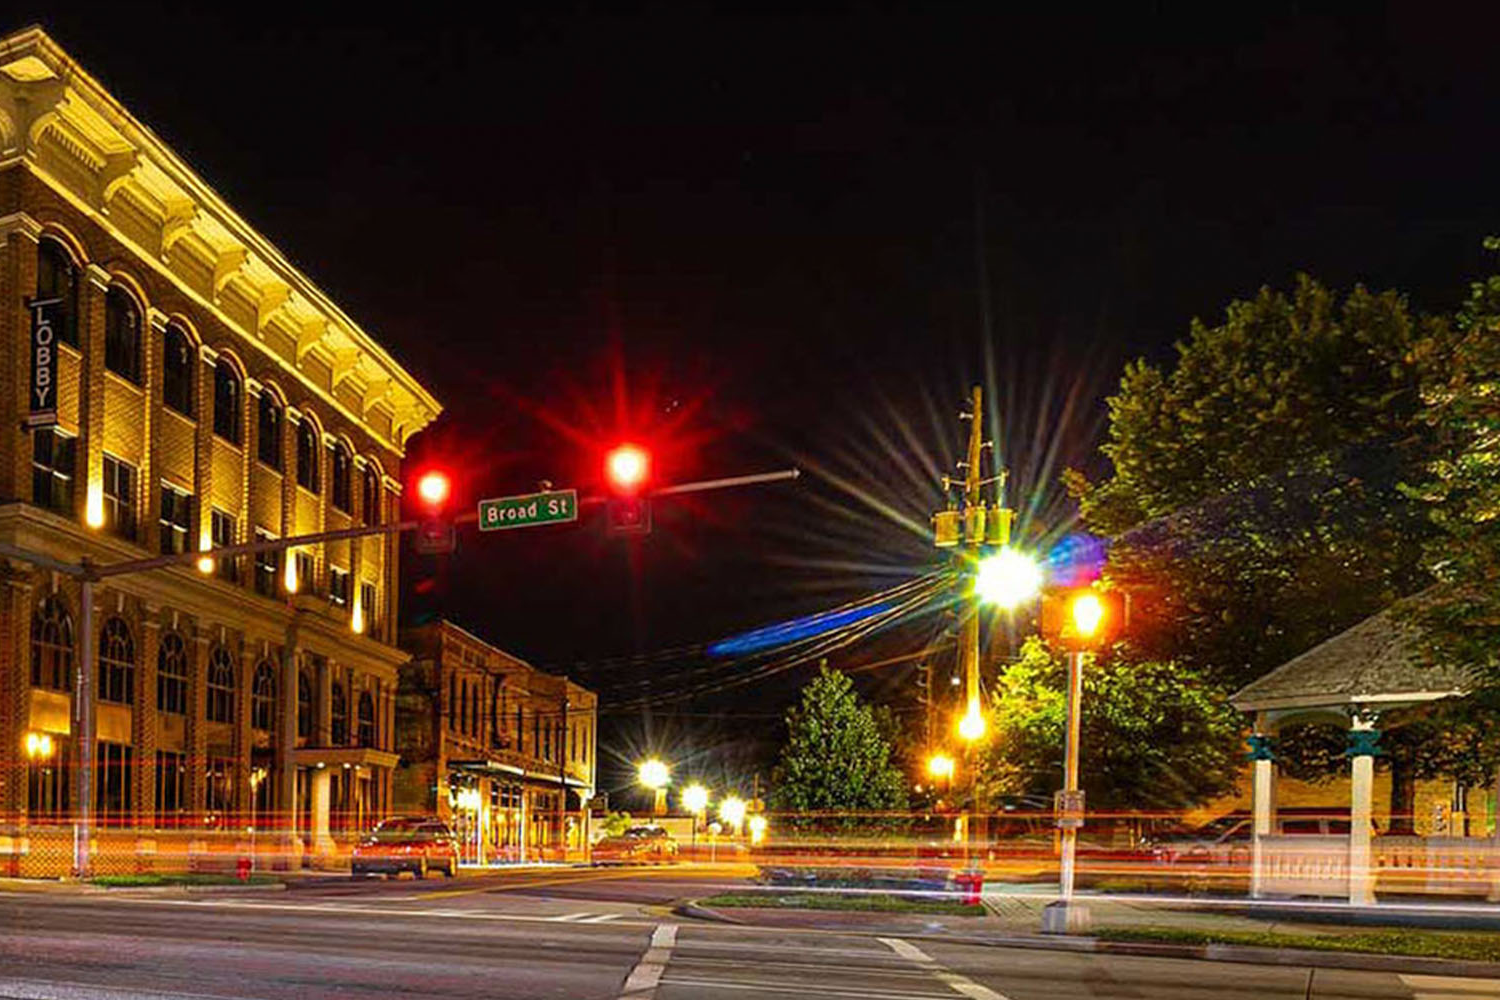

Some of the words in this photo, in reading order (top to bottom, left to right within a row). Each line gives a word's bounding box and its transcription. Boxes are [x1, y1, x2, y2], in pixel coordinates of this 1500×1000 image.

[35, 306, 53, 407] LOBBY
[487, 502, 537, 522] Broad
[548, 499, 567, 515] St
